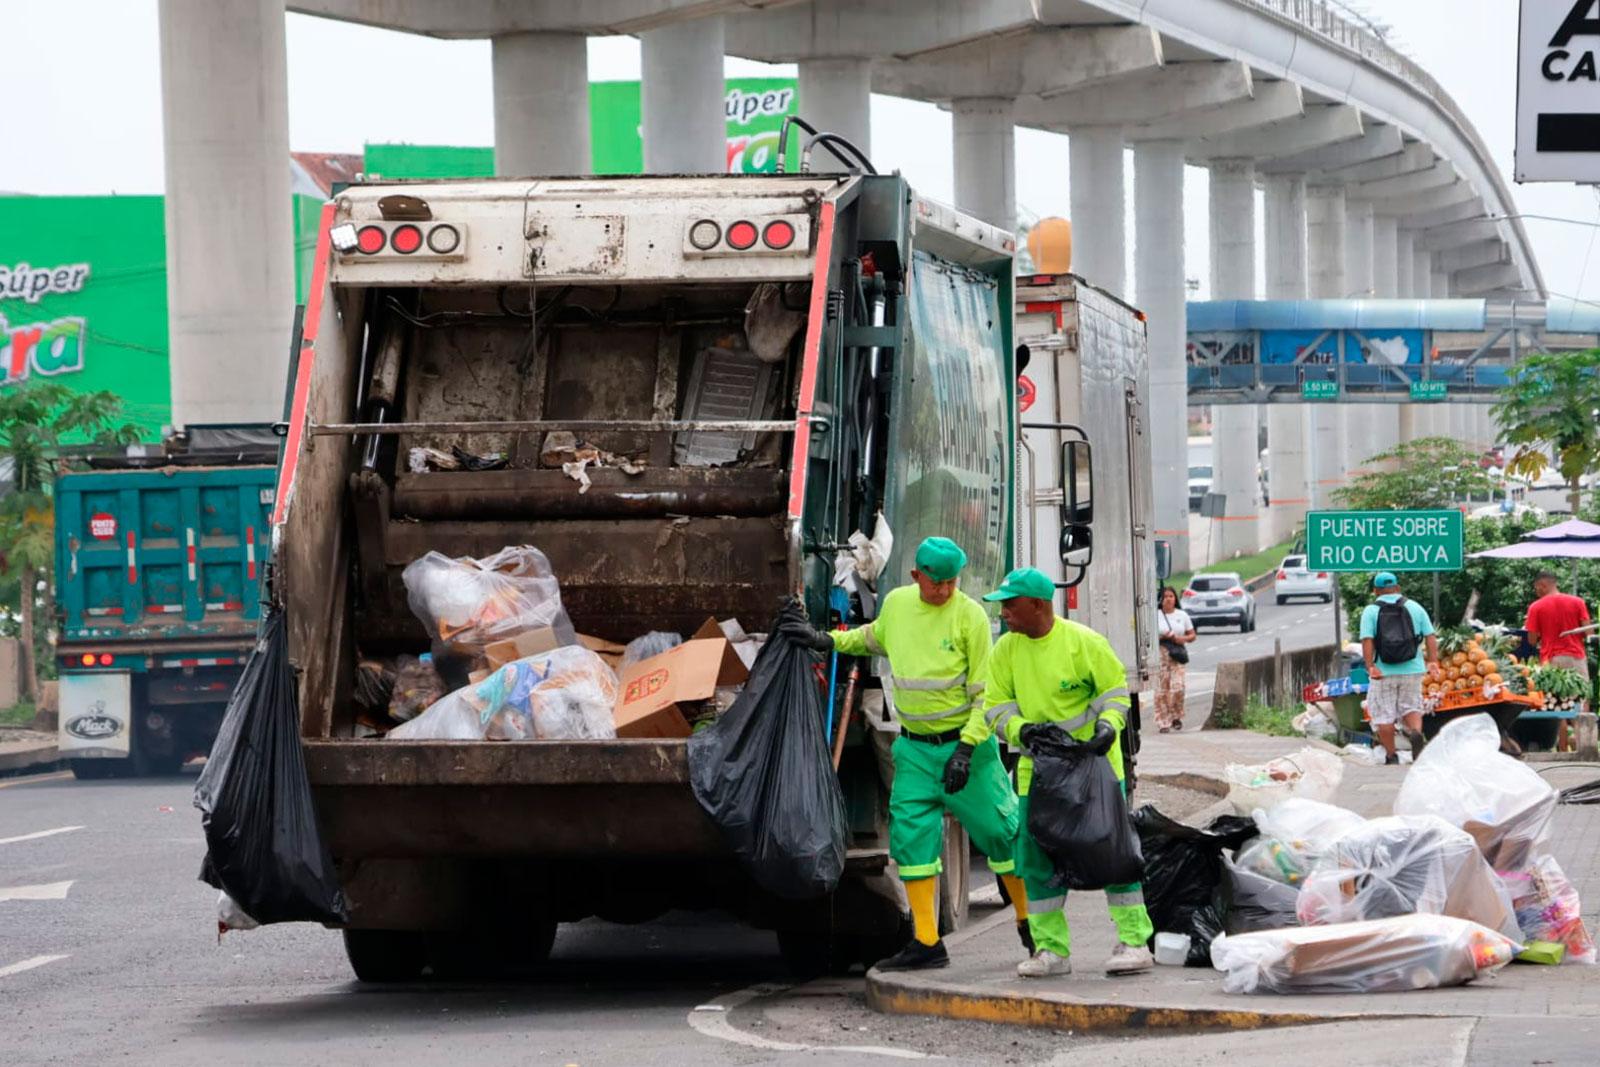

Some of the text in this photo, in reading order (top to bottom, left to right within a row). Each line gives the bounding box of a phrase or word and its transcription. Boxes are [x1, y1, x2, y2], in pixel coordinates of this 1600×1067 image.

[1541, 49, 1600, 82] CA
[725, 92, 790, 121] úper
[0, 320, 81, 380] ra
[1320, 517, 1449, 537] PUENTE SOBRE
[1320, 545, 1449, 564] RIO CABUYA
[75, 718, 114, 732] Mack
